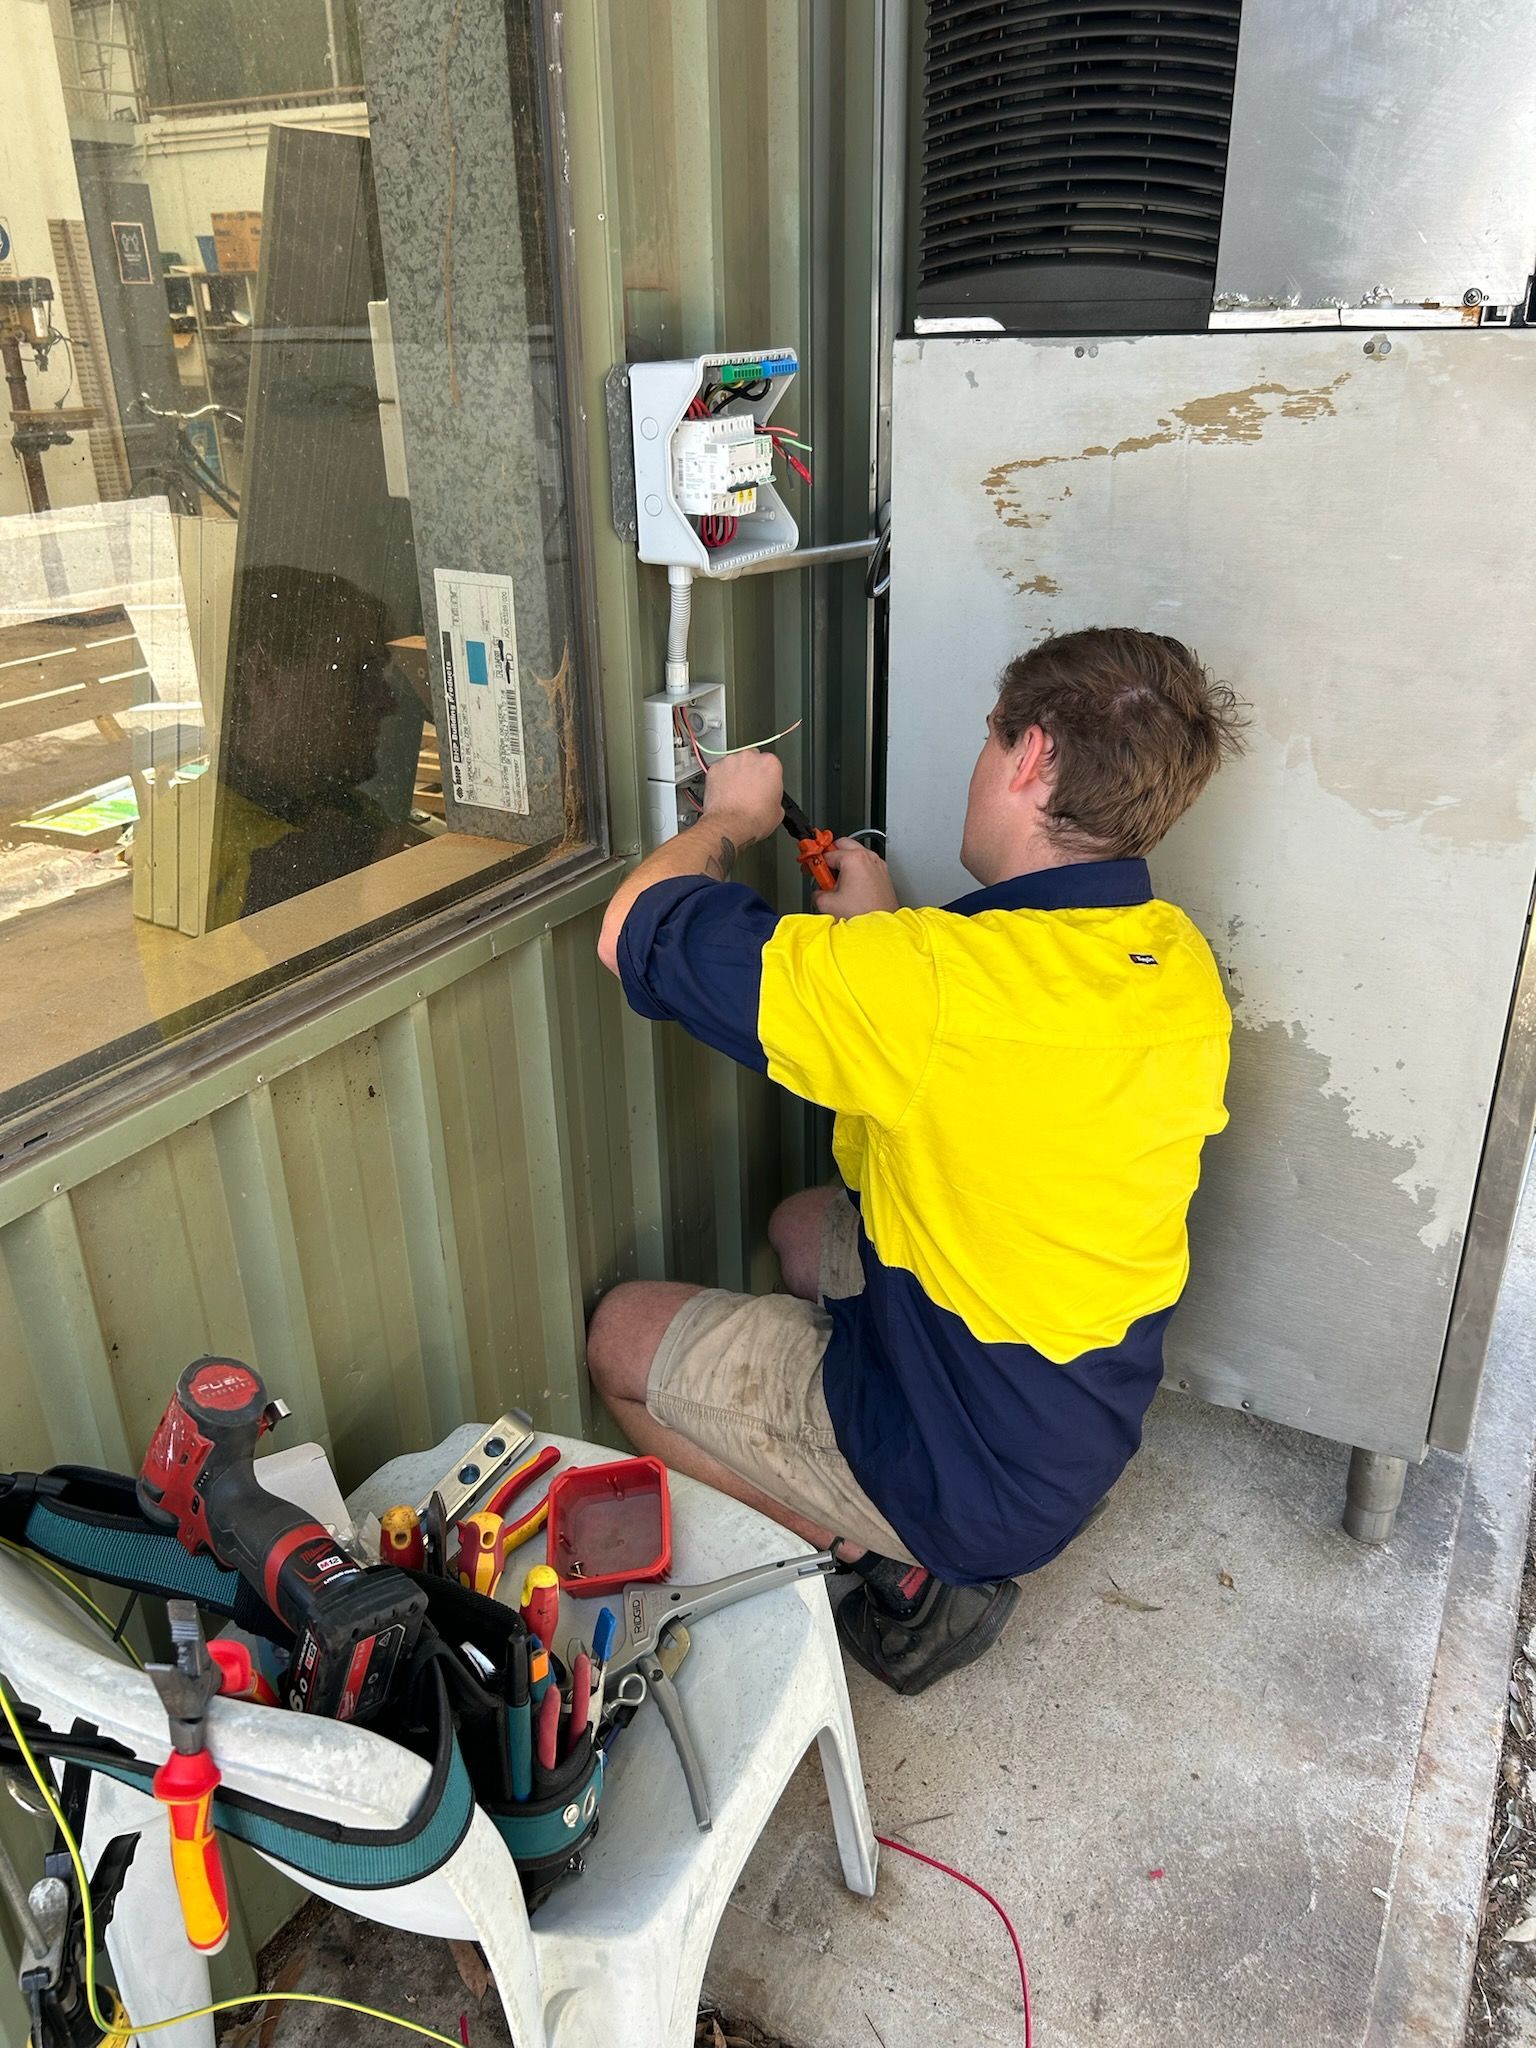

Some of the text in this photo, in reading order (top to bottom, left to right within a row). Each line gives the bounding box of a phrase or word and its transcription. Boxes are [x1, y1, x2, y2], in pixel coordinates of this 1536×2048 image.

[446, 660, 455, 702] Products
[450, 704, 458, 740] Building
[198, 1375, 248, 1393] FUEL
[320, 1557, 340, 1569] M12
[632, 1599, 642, 1634] RIDGID
[289, 1677, 308, 1712] 6.0
